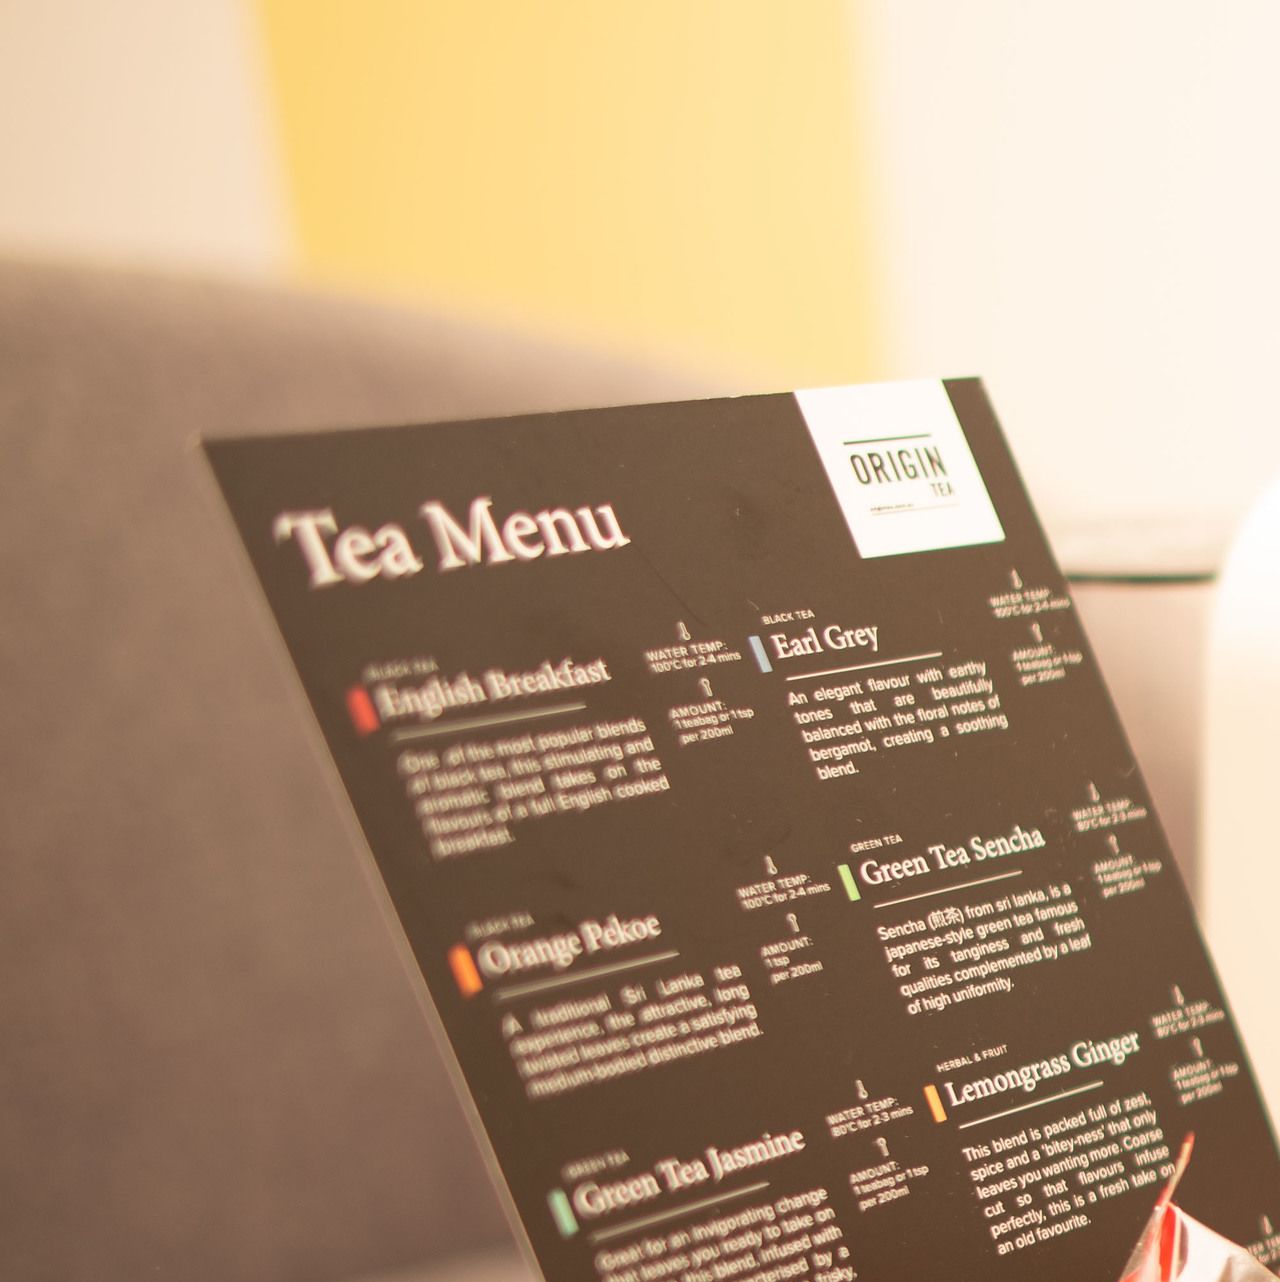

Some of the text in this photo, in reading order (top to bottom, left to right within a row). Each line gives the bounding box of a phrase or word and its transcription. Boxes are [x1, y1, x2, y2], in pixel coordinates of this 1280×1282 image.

[849, 446, 947, 485] ORIGIN
[930, 482, 954, 497] TEA
[276, 498, 632, 584] Tea Menu
[762, 609, 816, 625] BLACK TEA
[770, 625, 879, 659] Earl Grey
[377, 675, 488, 718] English
[485, 659, 613, 699] Breakfast
[788, 661, 987, 706] An elegant flavour with earthy
[794, 678, 994, 724] tones that are beautifully
[802, 694, 1001, 743] balanced with the floral notes of
[809, 715, 1010, 761] bergamot, creating a soothing
[816, 761, 860, 780] blend.
[850, 834, 904, 853] GREEN TEA
[860, 825, 1047, 885] Green Tea Sencha
[738, 874, 811, 898] WATER TEMP:
[877, 920, 928, 941] Sencha
[964, 903, 995, 919] from
[995, 896, 1013, 912] sri
[1012, 890, 1050, 908] lanka,
[1049, 885, 1062, 899] is
[1062, 884, 1073, 896] a
[884, 901, 1079, 963] japanese-style green tea famous
[478, 915, 662, 973] Orange Pekoe
[761, 936, 813, 957] AMOUNT:
[892, 917, 1086, 977] for its tanginess and fresh
[900, 933, 1092, 998] qualities complemented by a leaf
[771, 961, 824, 984] per 200ml
[907, 977, 1015, 1015] of high uniformity.
[936, 1044, 1008, 1072] HERBAL & FRUIT
[944, 1033, 1141, 1106] Lemongrass Ginger
[962, 1092, 1152, 1162] This blend is packed full of zest,
[970, 1162, 1005, 1182] spice
[1006, 1150, 1031, 1169] and
[1031, 1150, 1042, 1161] a
[1107, 1117, 1133, 1136] that
[1132, 1110, 1157, 1128] only
[574, 1174, 662, 1214] Green
[657, 1160, 711, 1190] Tea
[706, 1131, 807, 1180] Jasmine
[976, 1128, 1164, 1199] leaves you wanting more. Coarse
[984, 1146, 1170, 1218] cut so that flavours infuse
[990, 1209, 1048, 1239] perfectly,
[1048, 1199, 1072, 1216] this
[1073, 1194, 1086, 1207] is
[1088, 1191, 1098, 1203] a
[1099, 1178, 1130, 1198] fresh
[1131, 1170, 1158, 1187] take
[998, 1214, 1092, 1255] an old favourite.
